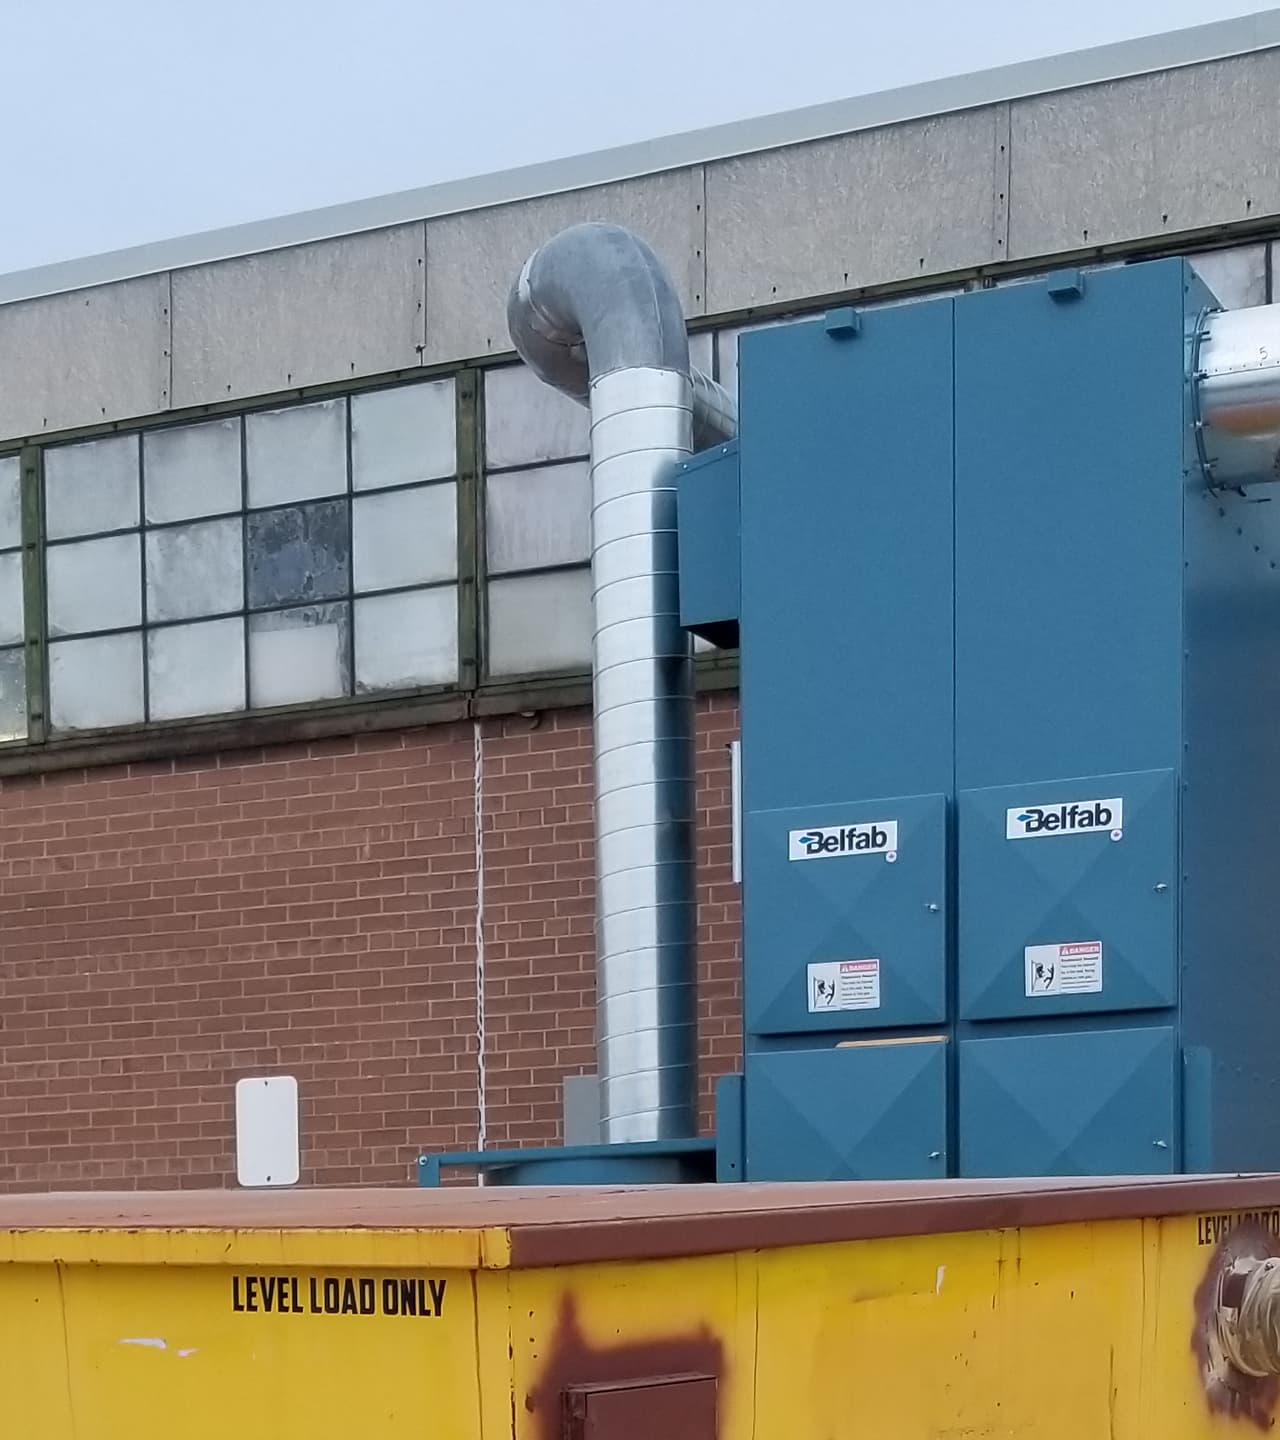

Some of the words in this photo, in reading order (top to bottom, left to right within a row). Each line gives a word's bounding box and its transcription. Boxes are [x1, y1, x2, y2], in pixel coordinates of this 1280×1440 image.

[1025, 803, 1113, 833] Belfab
[806, 825, 888, 855] Belfab
[232, 1276, 304, 1313] LEVEL
[309, 1277, 375, 1315] LOAD
[382, 1278, 447, 1317] ONLY
